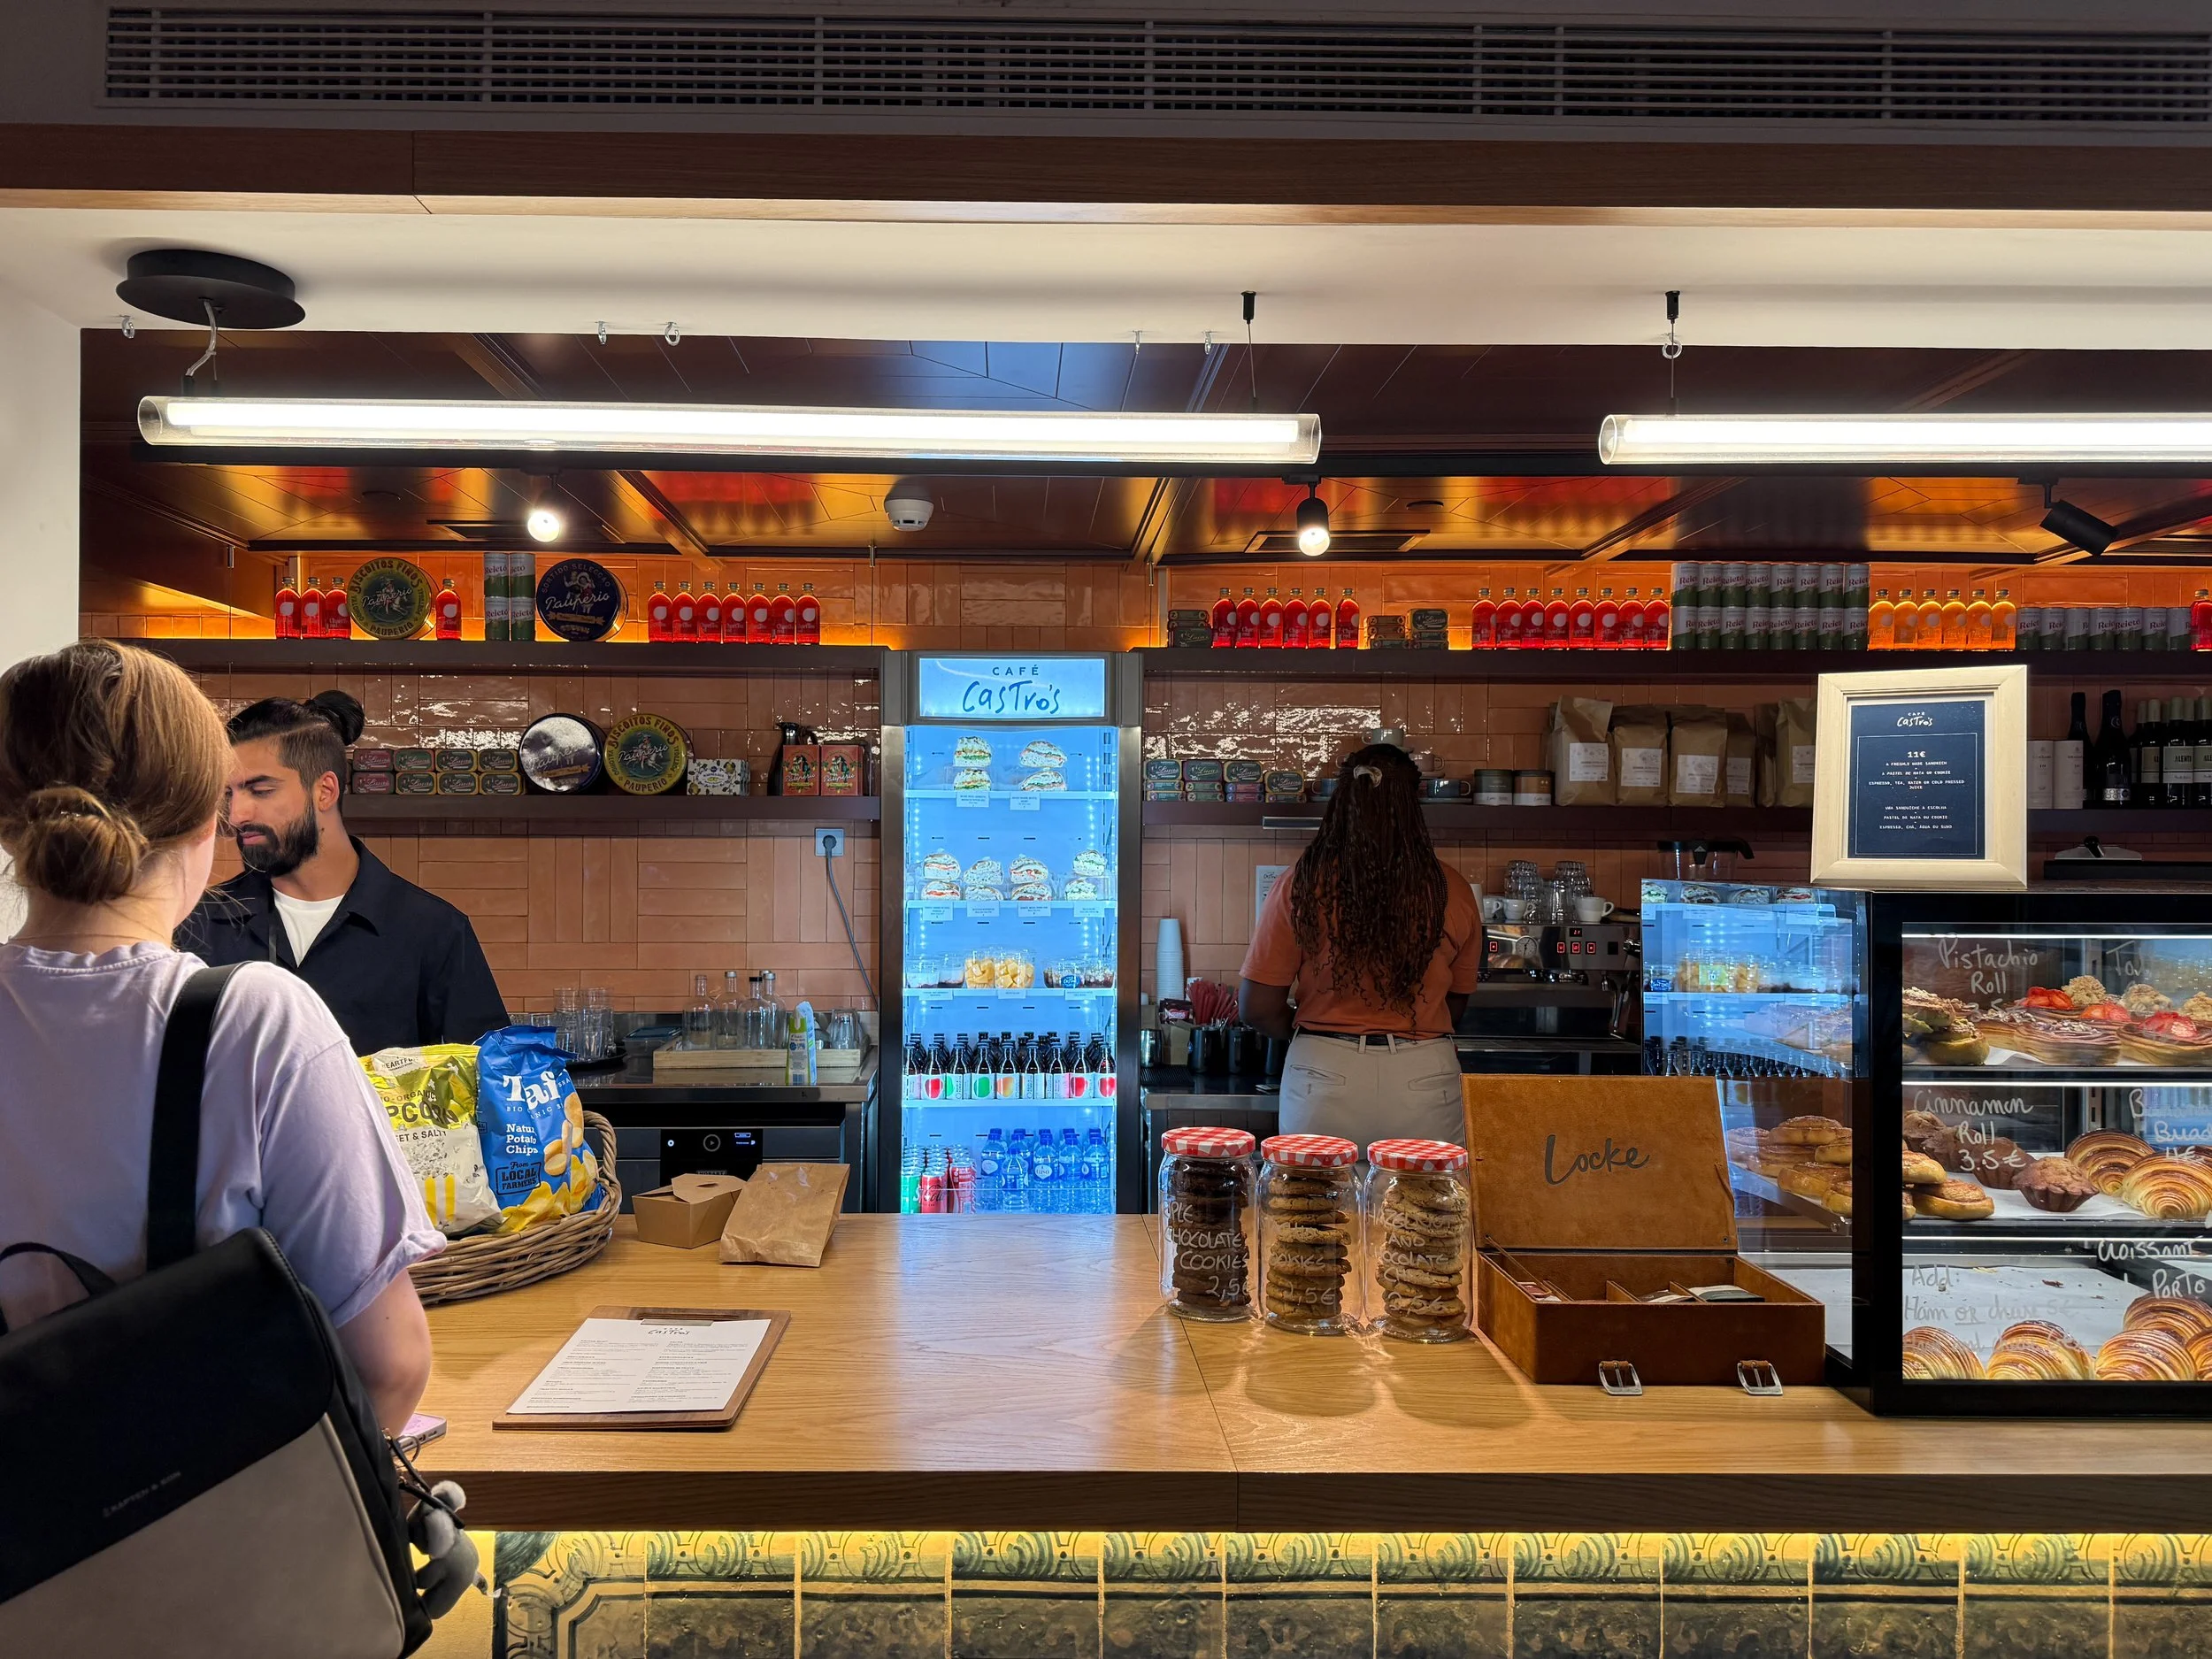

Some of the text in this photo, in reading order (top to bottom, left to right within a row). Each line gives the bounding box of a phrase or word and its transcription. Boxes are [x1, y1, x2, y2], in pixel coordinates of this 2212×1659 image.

[349, 560, 423, 594] BISCOITOS FINOS
[541, 565, 569, 595] SORTIDO
[992, 664, 1040, 676] CAFÉ
[607, 716, 680, 749] BISCOITOS FINOS
[1938, 933, 2039, 970] Pistachio
[1970, 971, 2007, 995] Roll
[384, 1100, 460, 1125] PCORN
[1913, 1089, 2034, 1115] Cinnamon
[1956, 1120, 1995, 1146] Roll
[510, 1161, 529, 1171] From
[1543, 1133, 1650, 1186] Locke
[501, 1167, 538, 1182] LOCAL
[502, 1177, 538, 1191] FARMERS
[1164, 1226, 1243, 1249] CHOCOLATE
[1180, 1250, 1249, 1271] COOKIES
[1903, 1294, 1949, 1321] Ham
